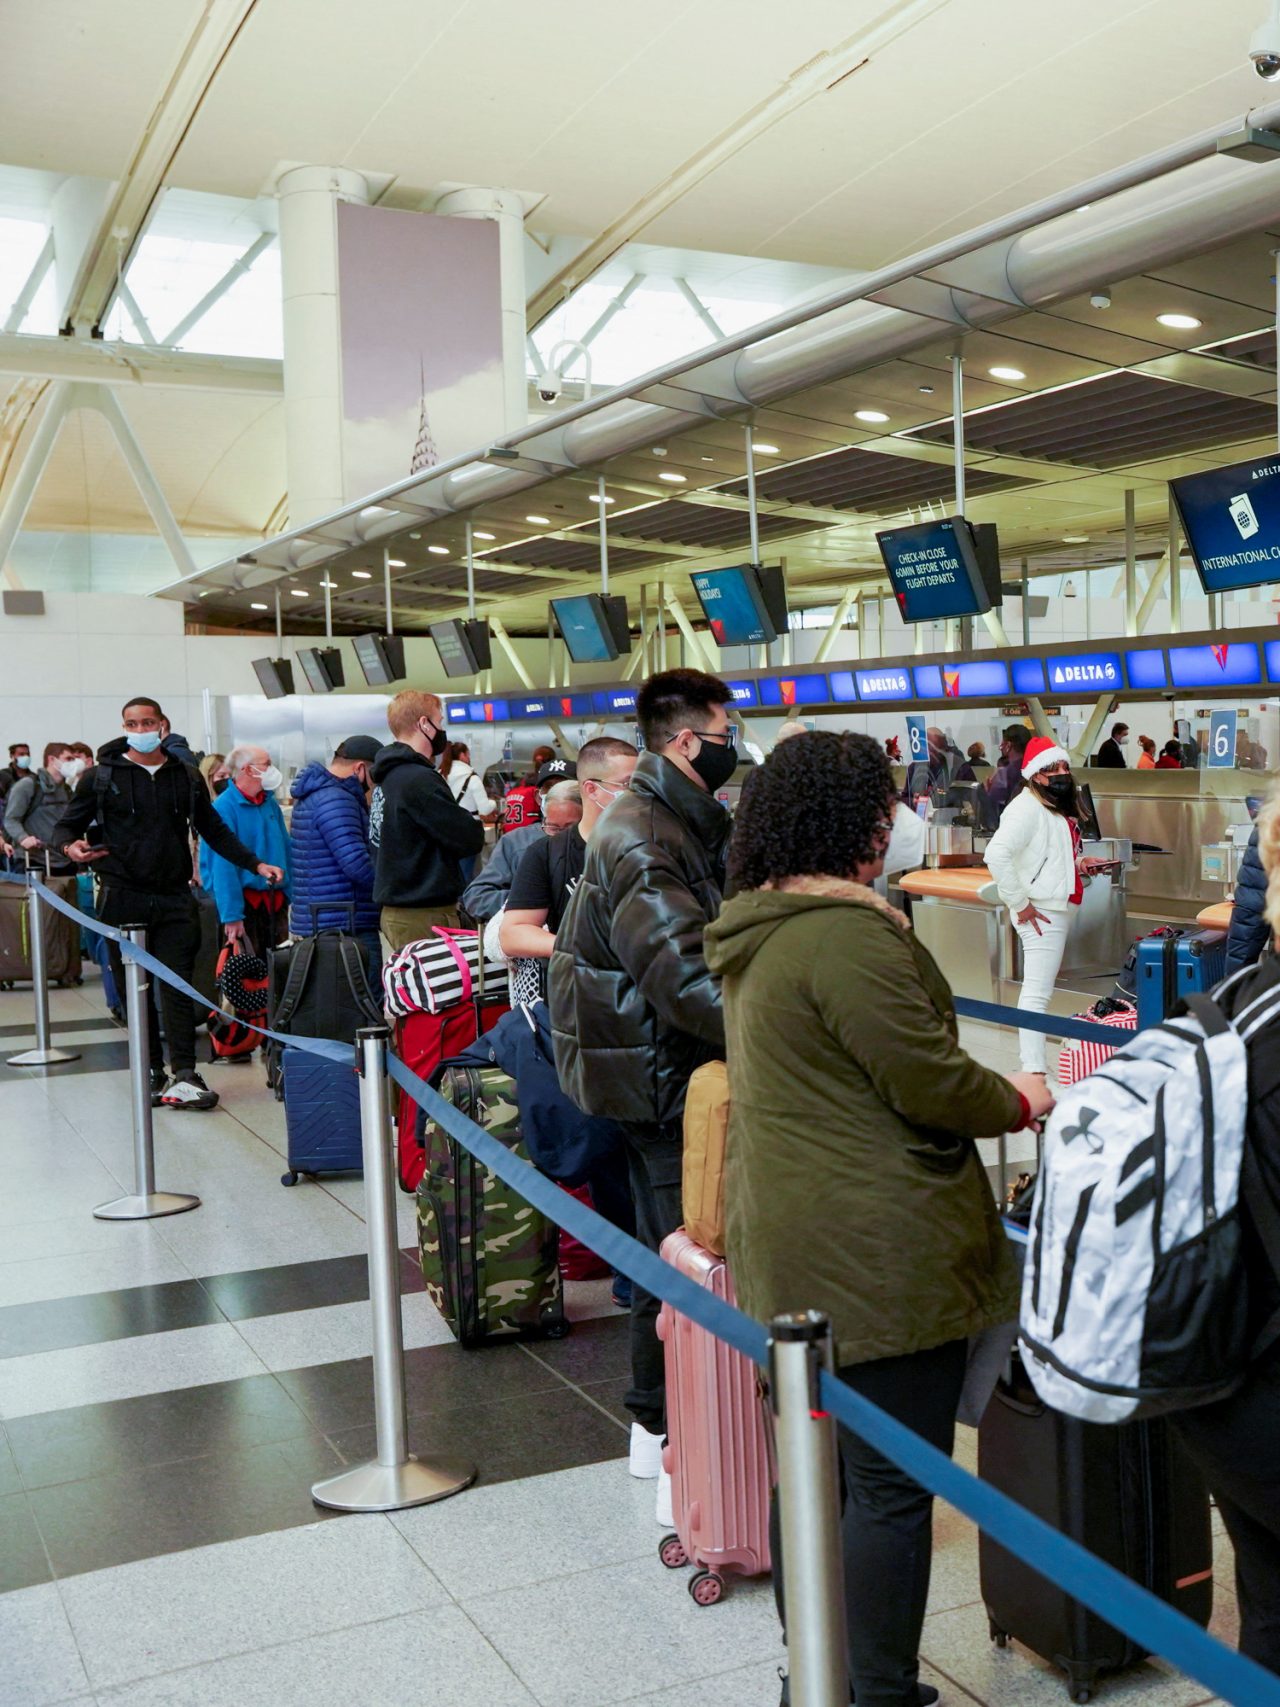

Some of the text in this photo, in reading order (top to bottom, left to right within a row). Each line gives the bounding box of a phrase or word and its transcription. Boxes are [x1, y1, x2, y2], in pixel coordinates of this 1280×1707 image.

[898, 547, 947, 564] CHECK-IN CLOSE
[1202, 549, 1272, 571] INTERNATIONAL
[896, 558, 959, 578] 60MIN BEFORE YOUR
[906, 573, 955, 590] FLIGHT DEPARTS
[1065, 664, 1104, 681] DELTA
[732, 688, 746, 699] ELTA
[869, 678, 899, 692] DELTA
[910, 727, 920, 753] 8
[1214, 724, 1228, 757] 6
[505, 803, 524, 824] 23
